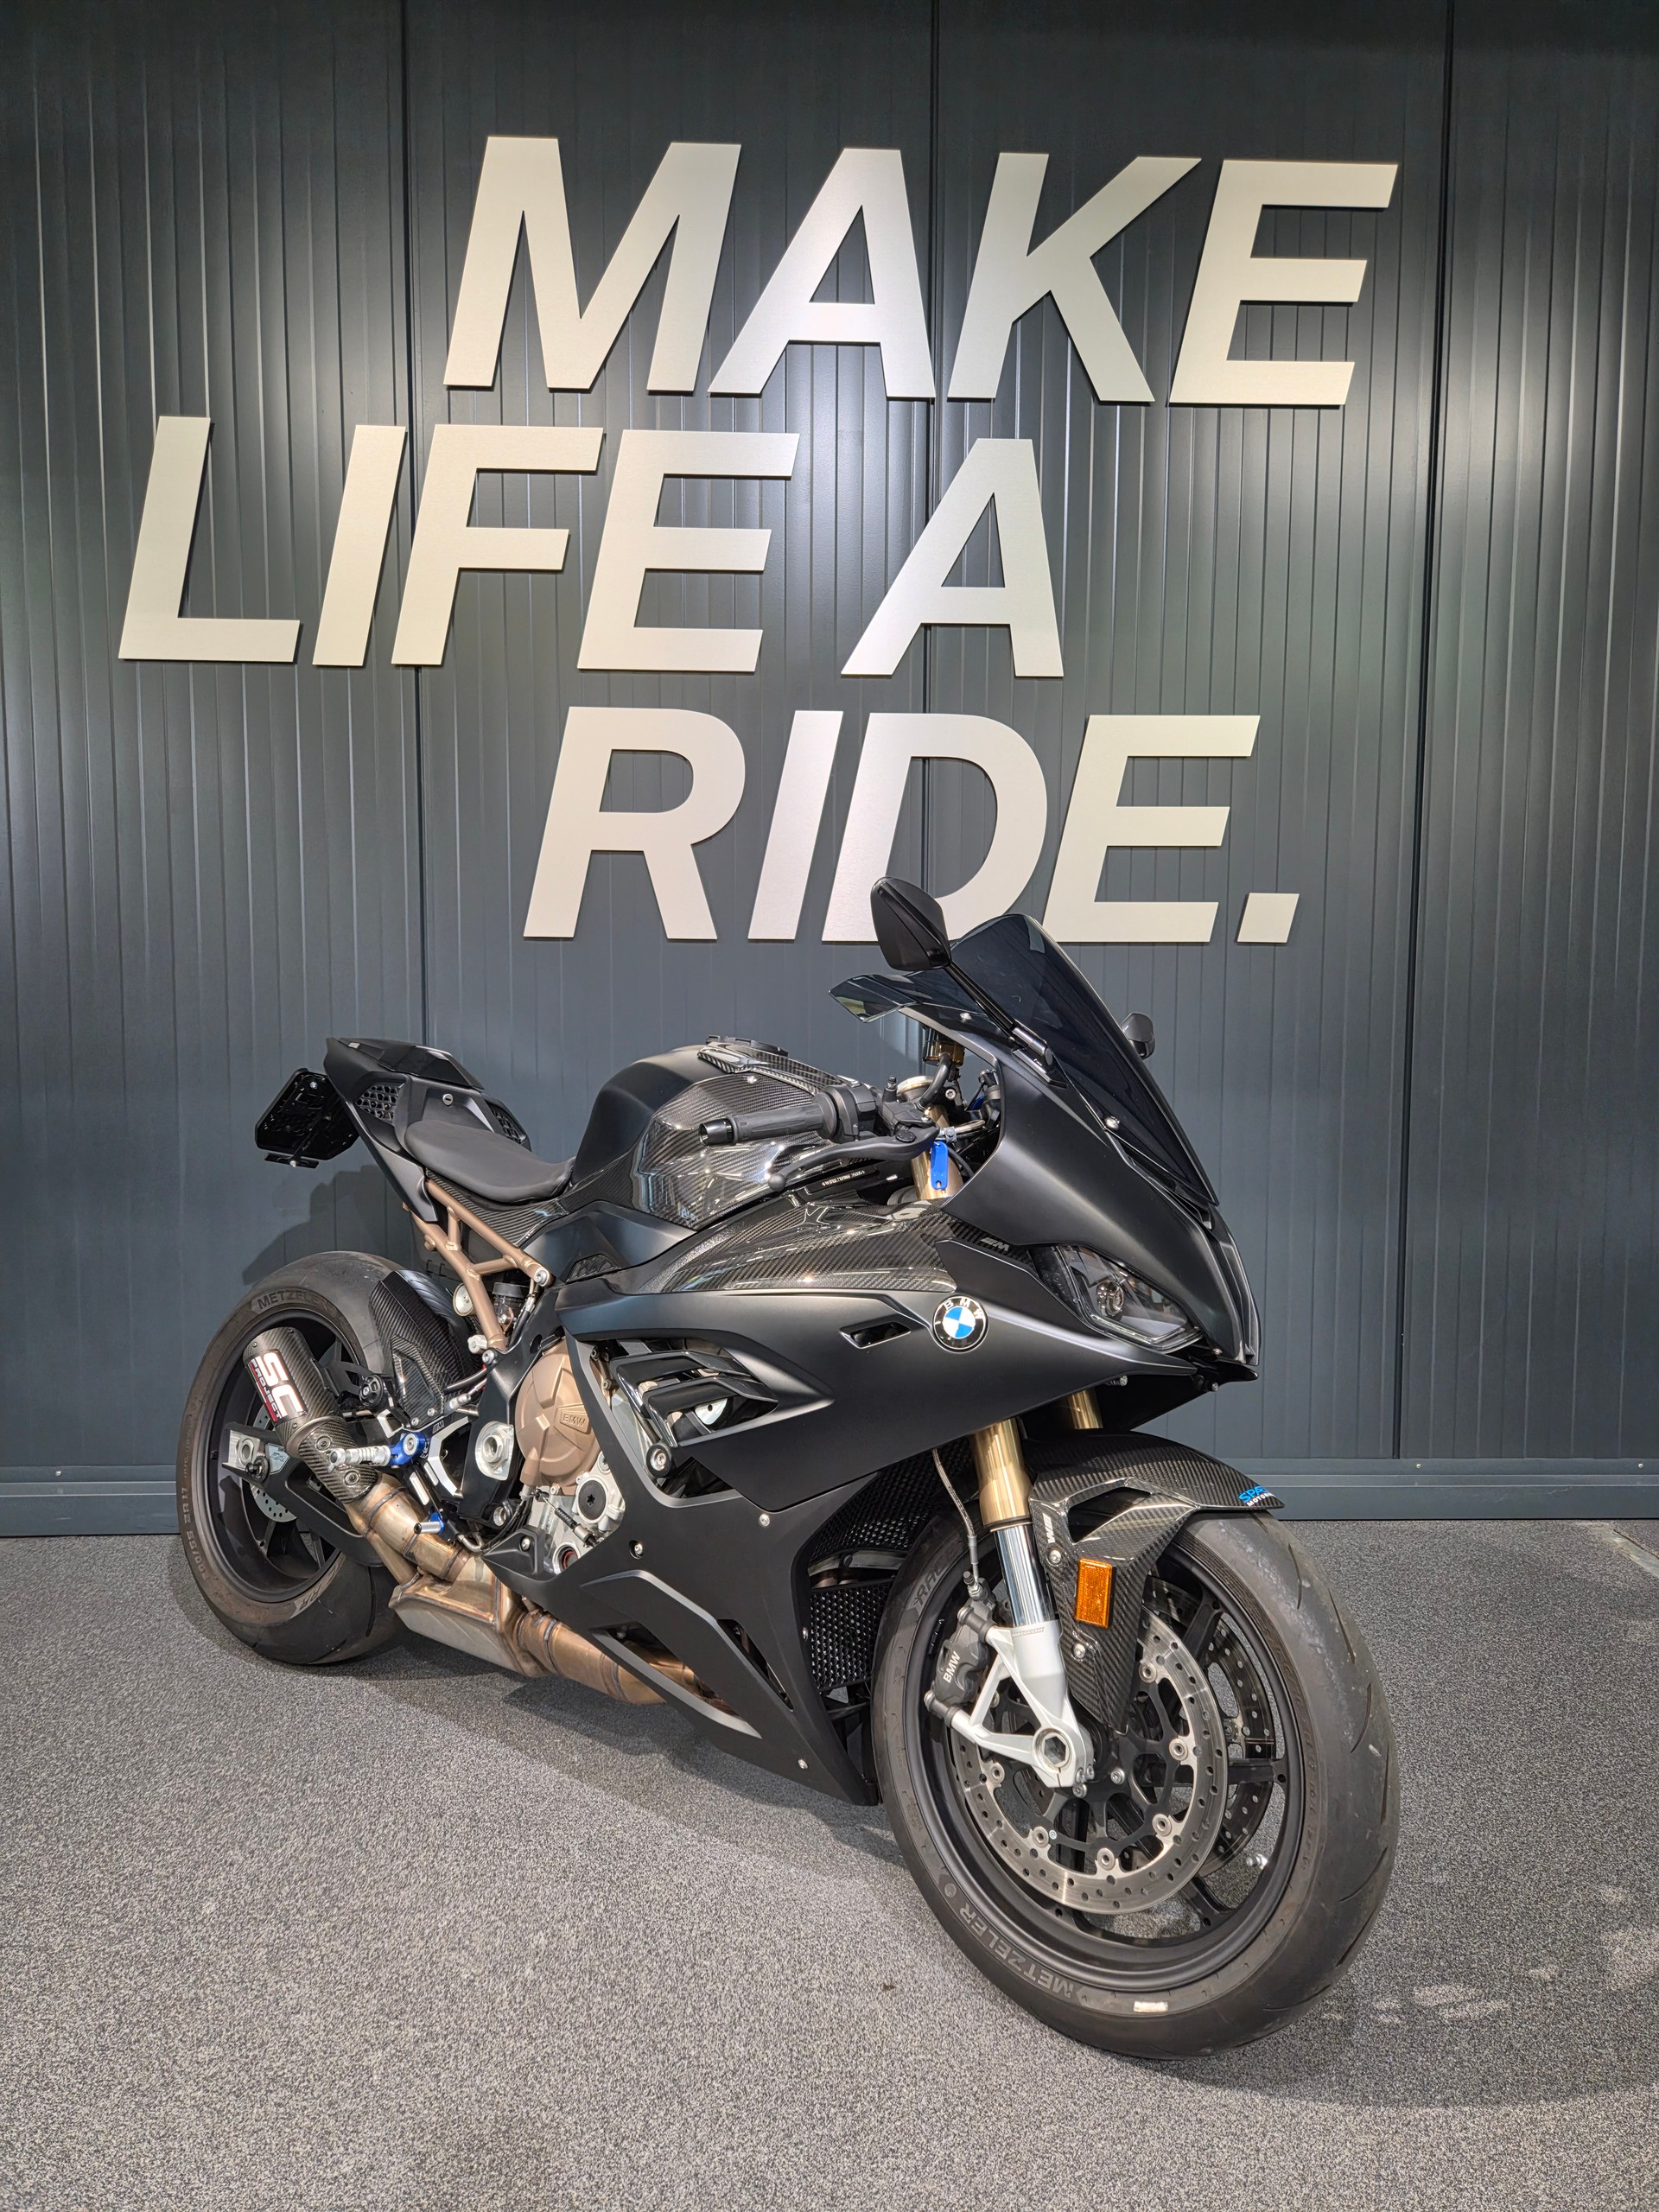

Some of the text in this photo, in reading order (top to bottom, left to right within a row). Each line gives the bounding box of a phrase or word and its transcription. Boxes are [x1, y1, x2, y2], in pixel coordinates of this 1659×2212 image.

[444, 136, 1399, 407] MAKE
[118, 416, 1064, 678] LIFE A
[524, 707, 1300, 945] RIDE.
[943, 1298, 985, 1319] BMW
[250, 1357, 283, 1420] PROJECT
[255, 1351, 305, 1418] SC
[563, 1413, 586, 1427] BMW
[943, 1651, 961, 1683] BMW
[960, 1903, 1074, 1998] METZELER
